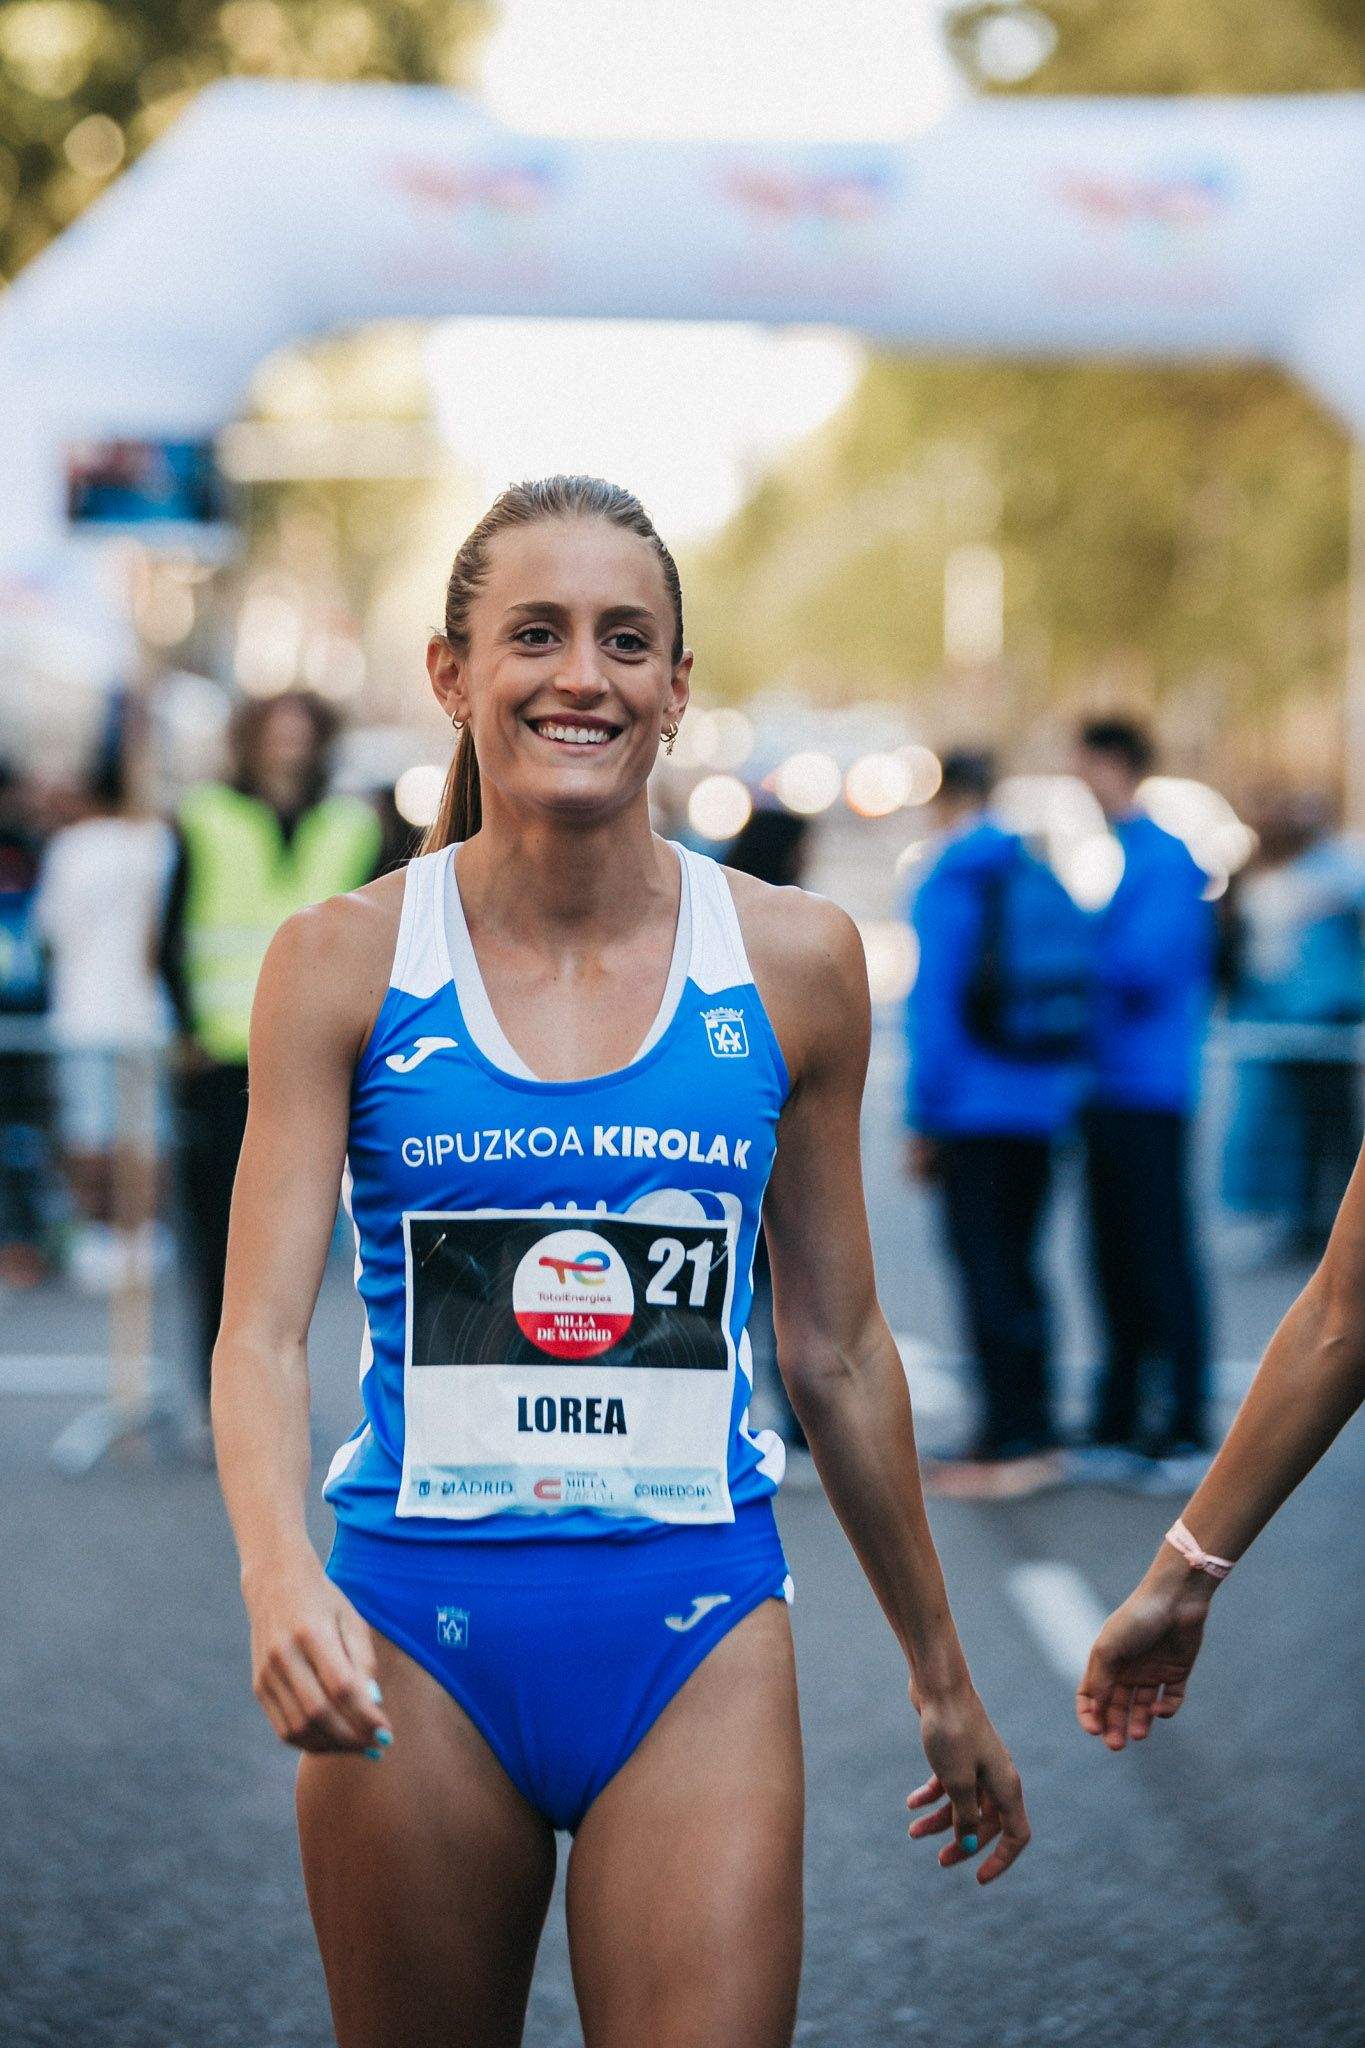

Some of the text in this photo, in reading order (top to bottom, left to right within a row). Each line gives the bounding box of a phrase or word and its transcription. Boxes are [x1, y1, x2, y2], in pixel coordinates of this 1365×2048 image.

[402, 1125, 751, 1170] GIPUZKOA KIROLAK
[646, 1237, 714, 1307] 21
[537, 1327, 612, 1341] DE MADRID
[554, 1314, 595, 1328] MILLA
[517, 1395, 628, 1435] LOREA
[441, 1479, 513, 1496] MADRID
